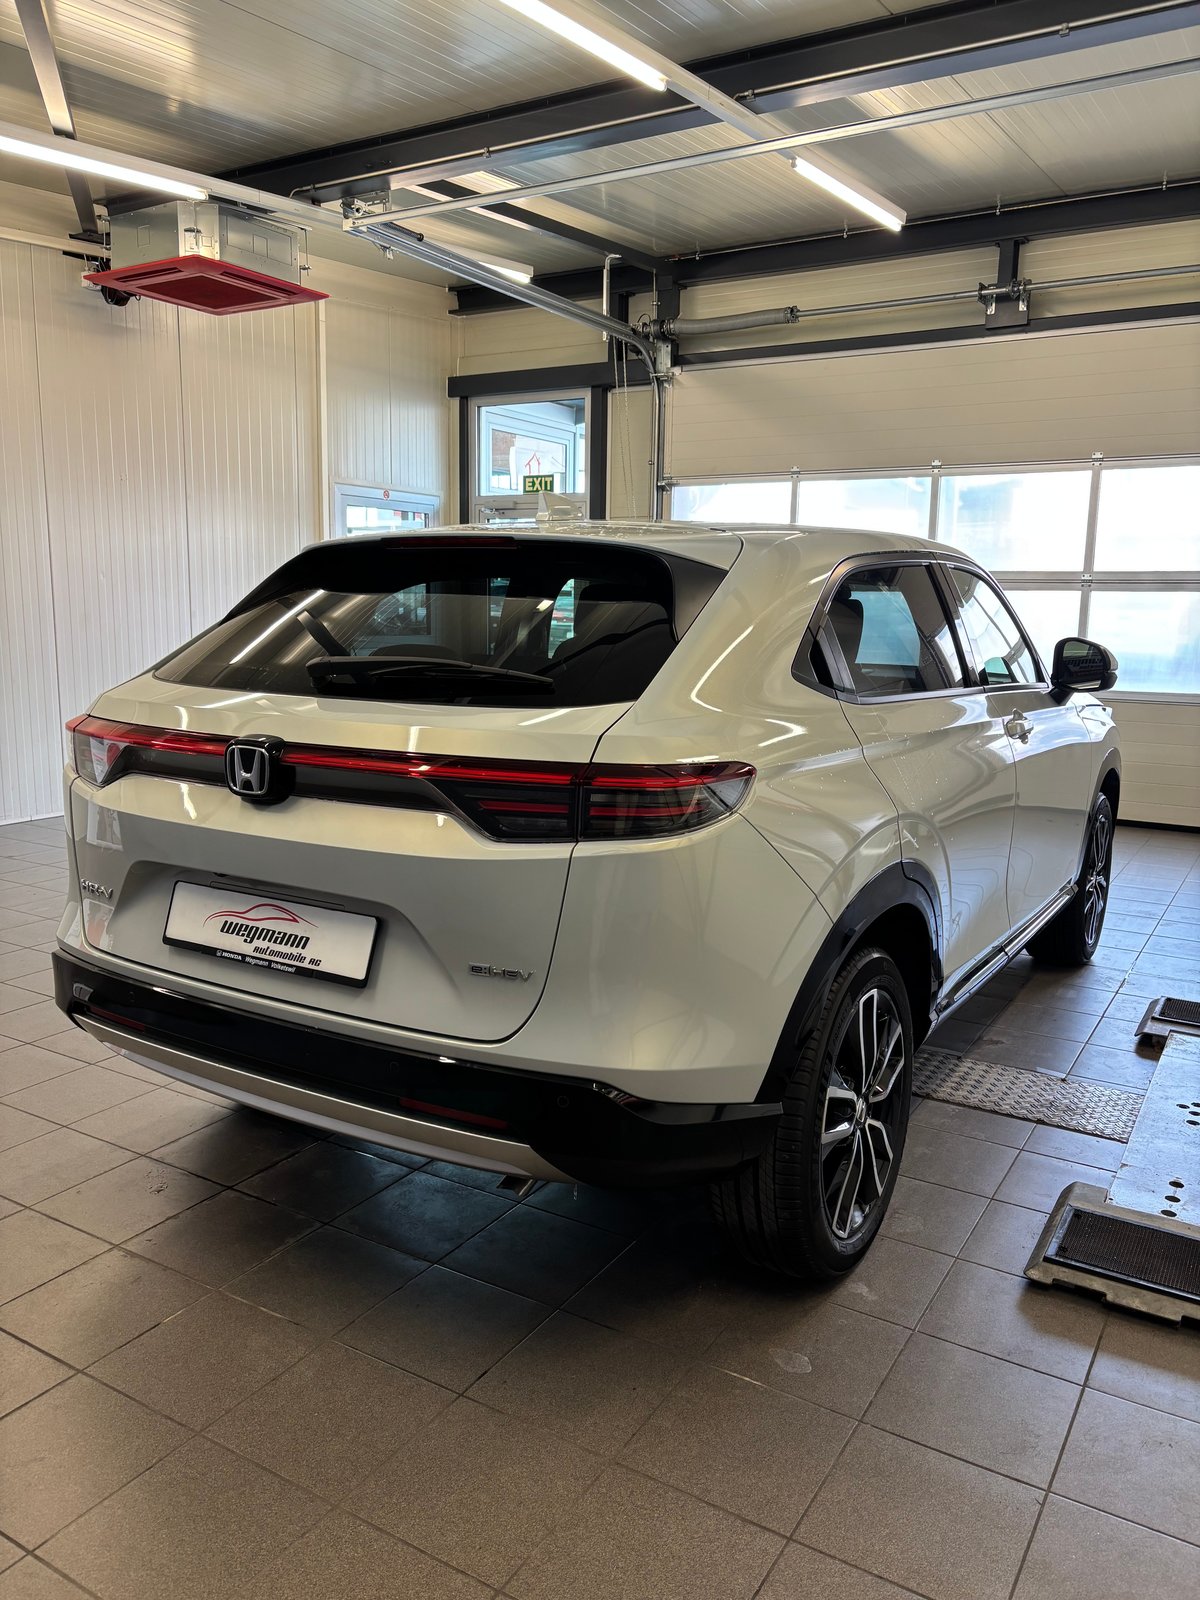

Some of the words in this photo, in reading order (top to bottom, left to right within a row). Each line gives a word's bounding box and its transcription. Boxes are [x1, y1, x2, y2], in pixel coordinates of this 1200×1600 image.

[525, 477, 552, 491] EXIT
[220, 920, 310, 950] wegmann
[222, 951, 242, 961] HONDA
[245, 956, 269, 966] Wegmann
[271, 962, 297, 973] Volketswil
[308, 957, 322, 967] AG
